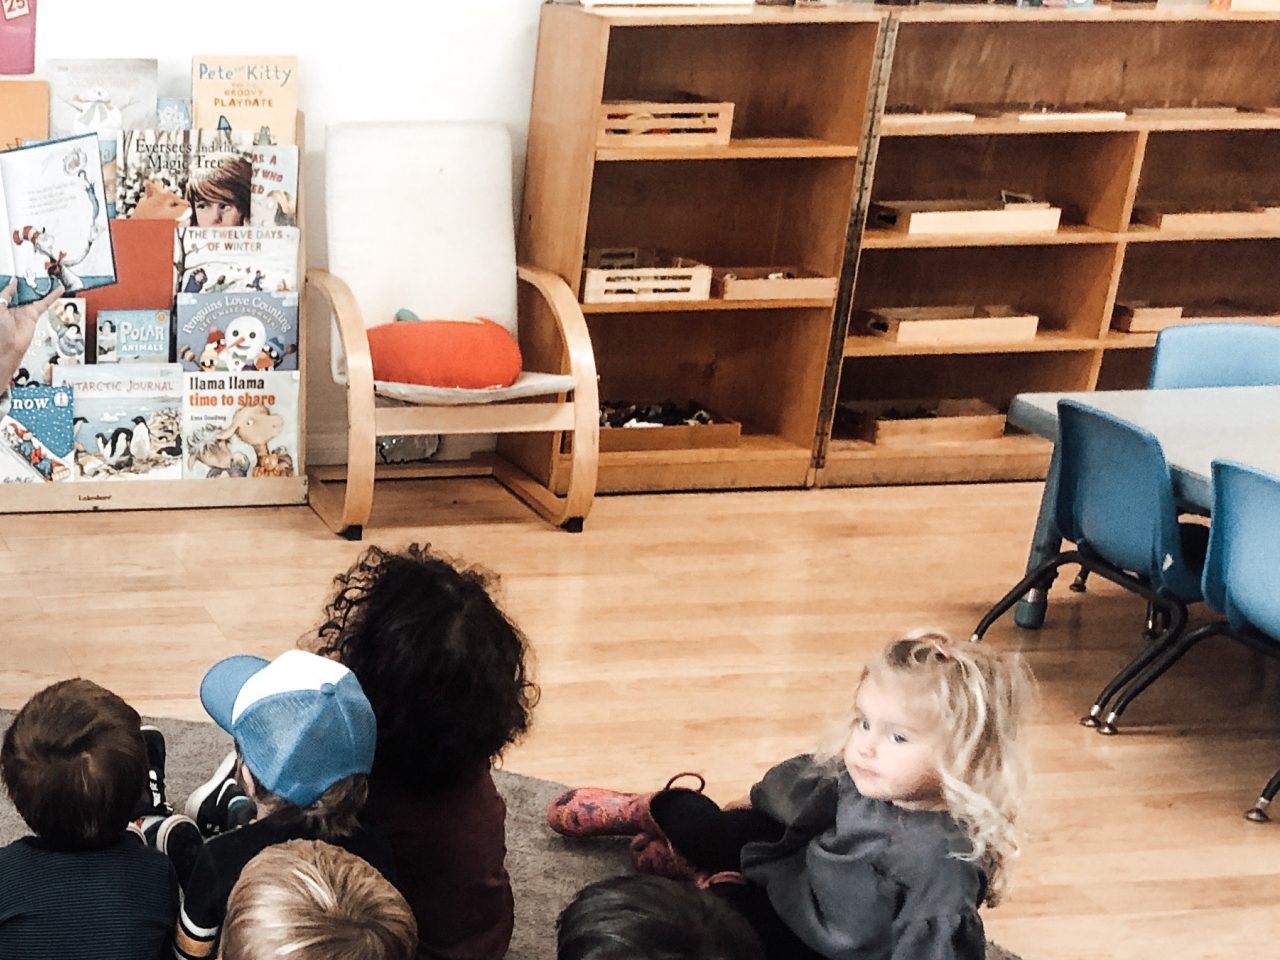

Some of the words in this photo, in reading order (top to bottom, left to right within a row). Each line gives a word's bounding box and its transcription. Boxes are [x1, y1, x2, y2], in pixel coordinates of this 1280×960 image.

[199, 63, 234, 80] Pete
[247, 65, 291, 87] Kitty
[224, 89, 263, 97] GROOVY
[214, 98, 273, 107] PLAYDATE
[147, 154, 189, 173] Magic
[194, 154, 225, 169] Tree
[251, 153, 264, 164] AS
[262, 169, 284, 183] WHO
[188, 230, 207, 239] THE
[213, 230, 253, 239] TWELVE
[256, 230, 283, 239] DAYS
[207, 242, 220, 251] OF
[224, 242, 262, 251] WINTER
[182, 300, 223, 334] Penguins
[225, 296, 250, 306] Love
[252, 297, 291, 333] Counting
[120, 321, 165, 343] POLAR
[121, 343, 164, 352] ANIMALS
[127, 380, 174, 392] JOURNAL
[189, 376, 225, 390] llama
[229, 376, 265, 390] llama
[12, 397, 50, 410] now
[189, 393, 218, 406] time
[221, 394, 234, 406] to
[238, 392, 276, 407] share
